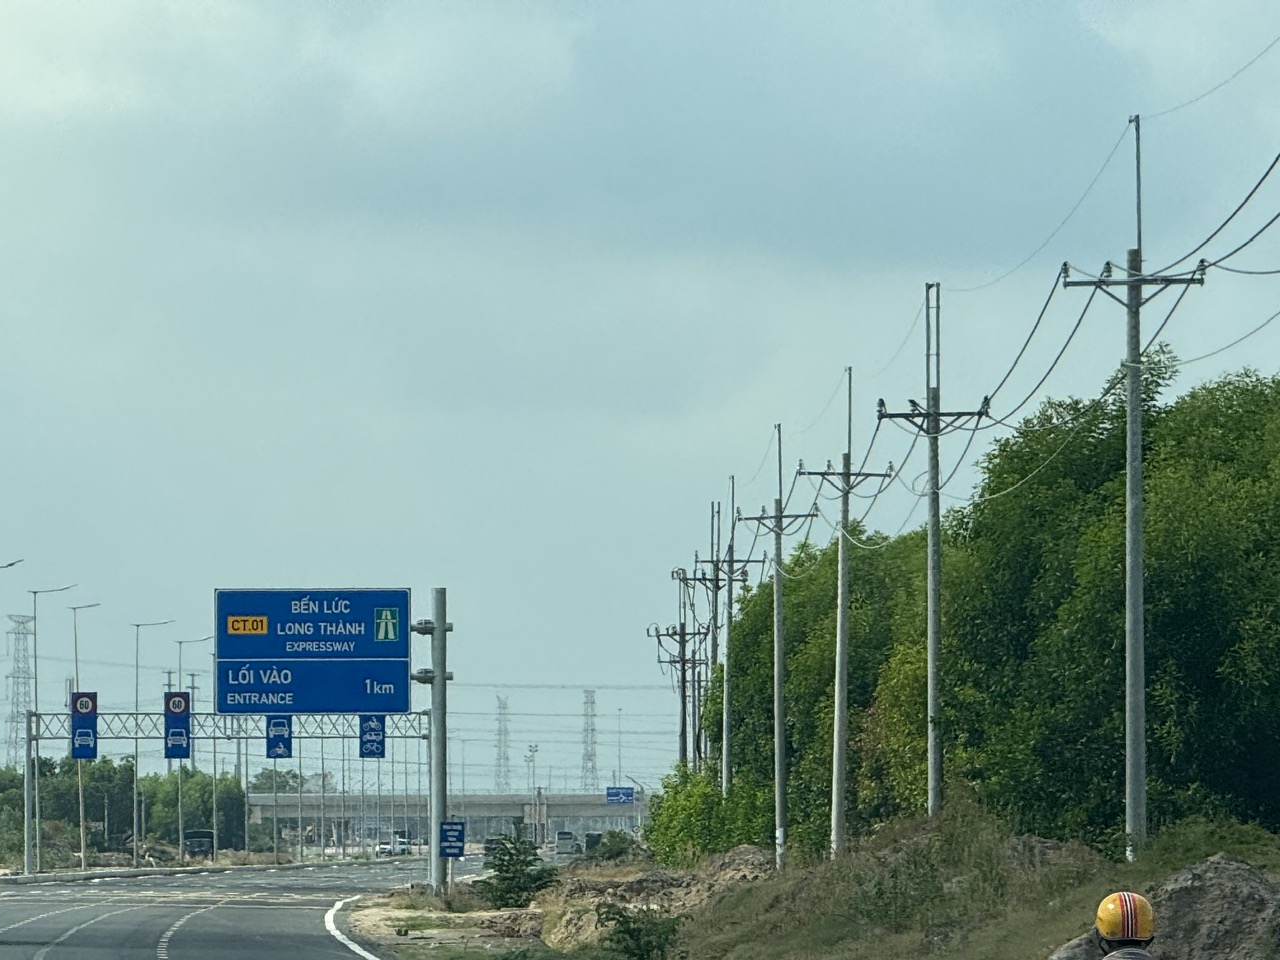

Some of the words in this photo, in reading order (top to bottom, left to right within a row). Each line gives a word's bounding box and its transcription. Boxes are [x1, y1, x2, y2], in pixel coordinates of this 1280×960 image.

[291, 595, 319, 614] BẾN
[323, 596, 351, 614] LỨC
[231, 619, 265, 632] CT.01
[277, 622, 314, 635] LONG
[319, 619, 365, 635] THÀNH
[285, 641, 356, 652] EXPRESSWAY
[228, 664, 254, 685] LỐI
[259, 666, 292, 685] VÀO
[80, 700, 90, 710] 60
[172, 700, 183, 710] 60
[226, 692, 294, 705] ENTRANCE
